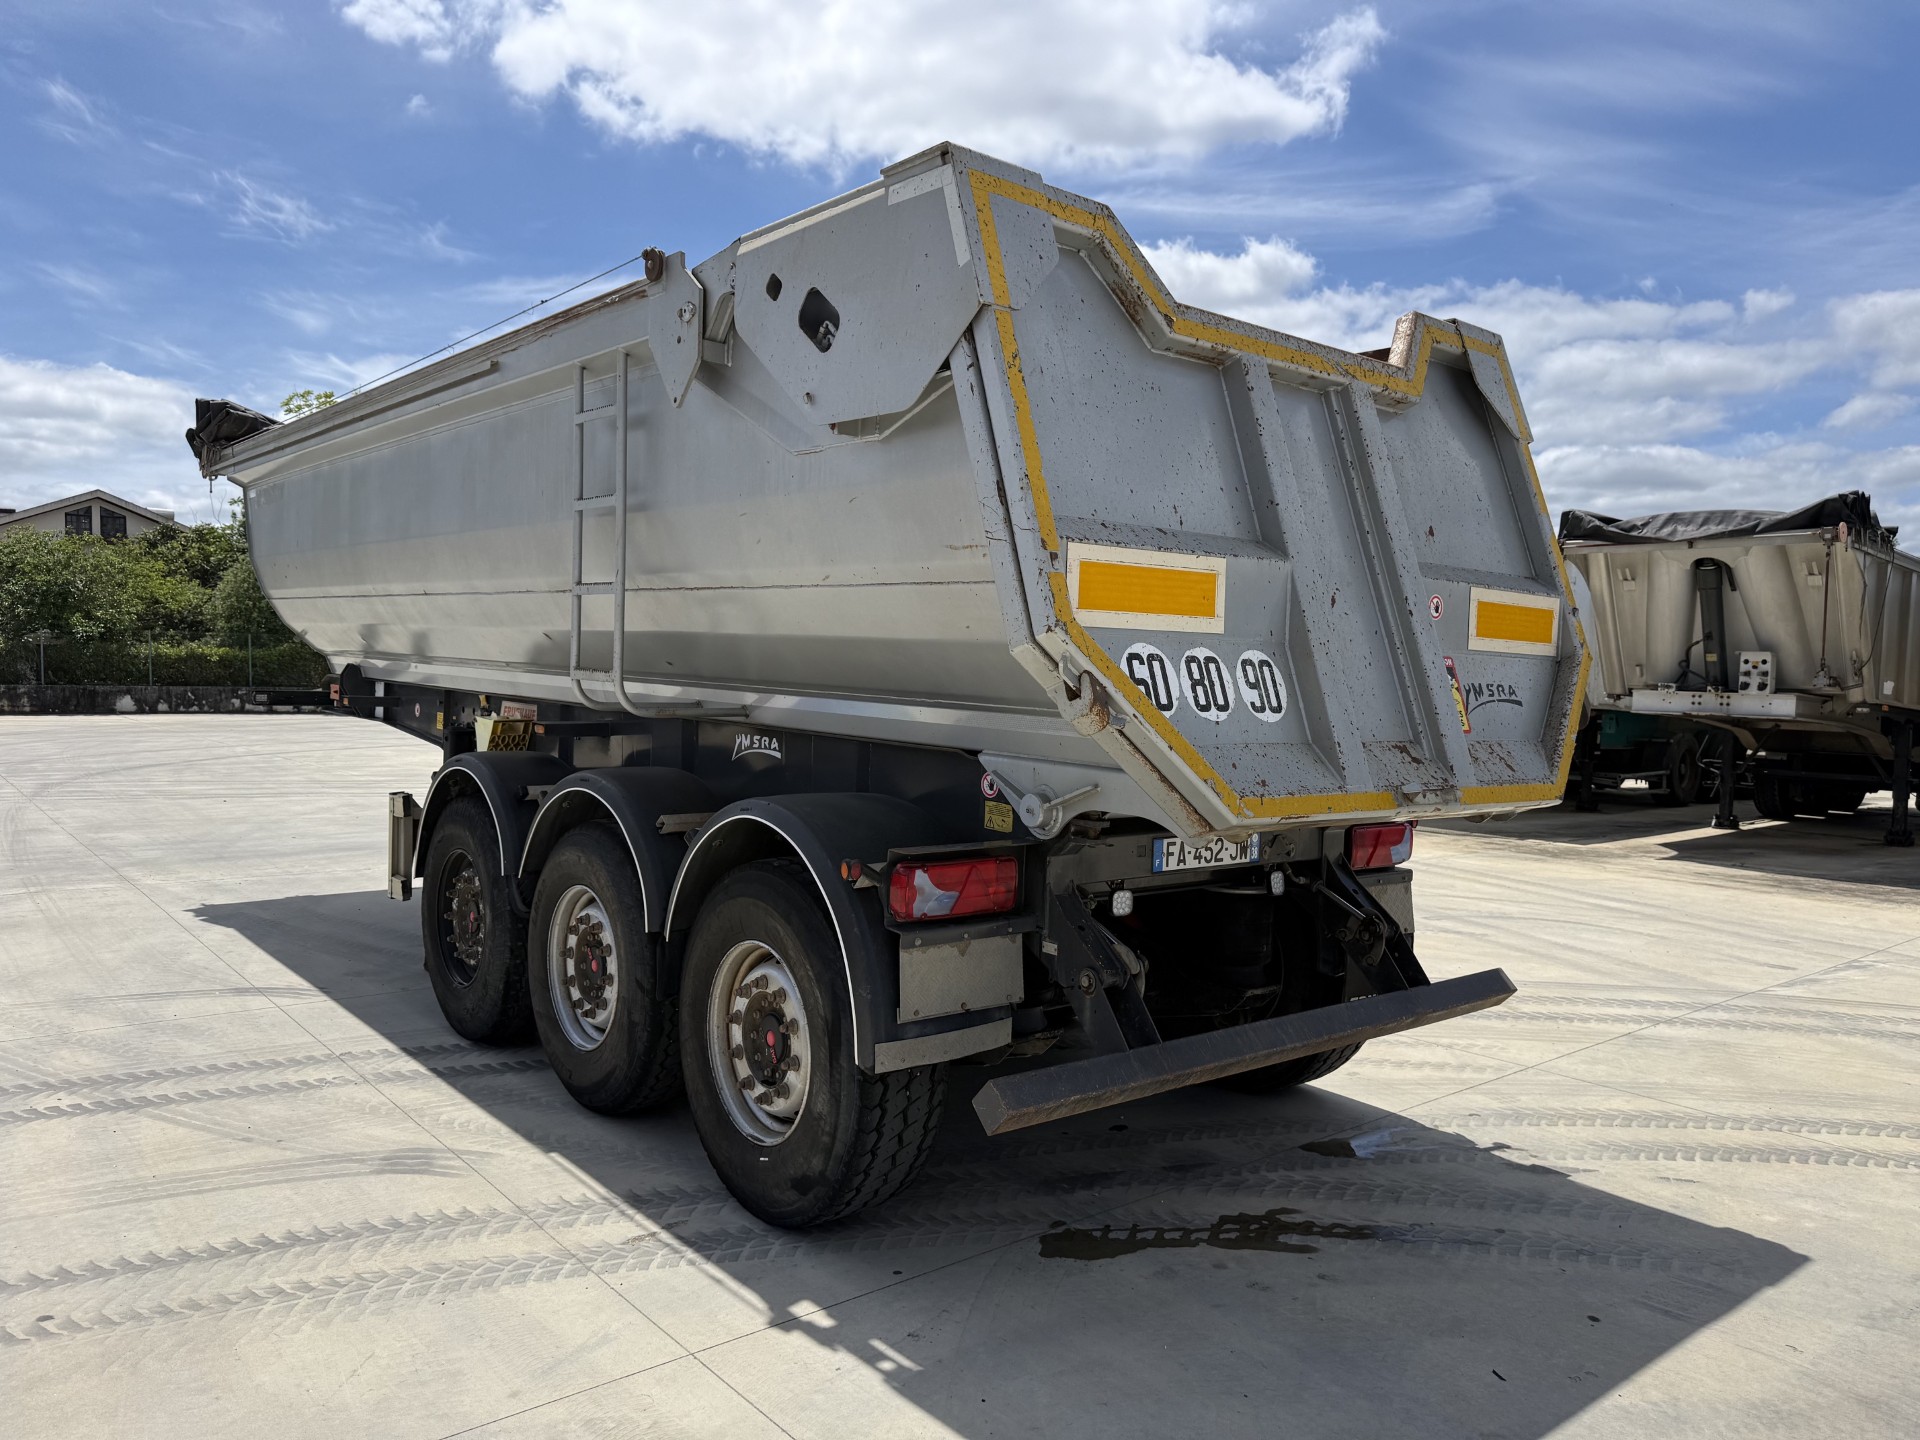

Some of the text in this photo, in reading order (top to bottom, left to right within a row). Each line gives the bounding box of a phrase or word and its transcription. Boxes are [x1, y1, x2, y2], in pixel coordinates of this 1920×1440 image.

[1126, 652, 1283, 714] 60 80 90
